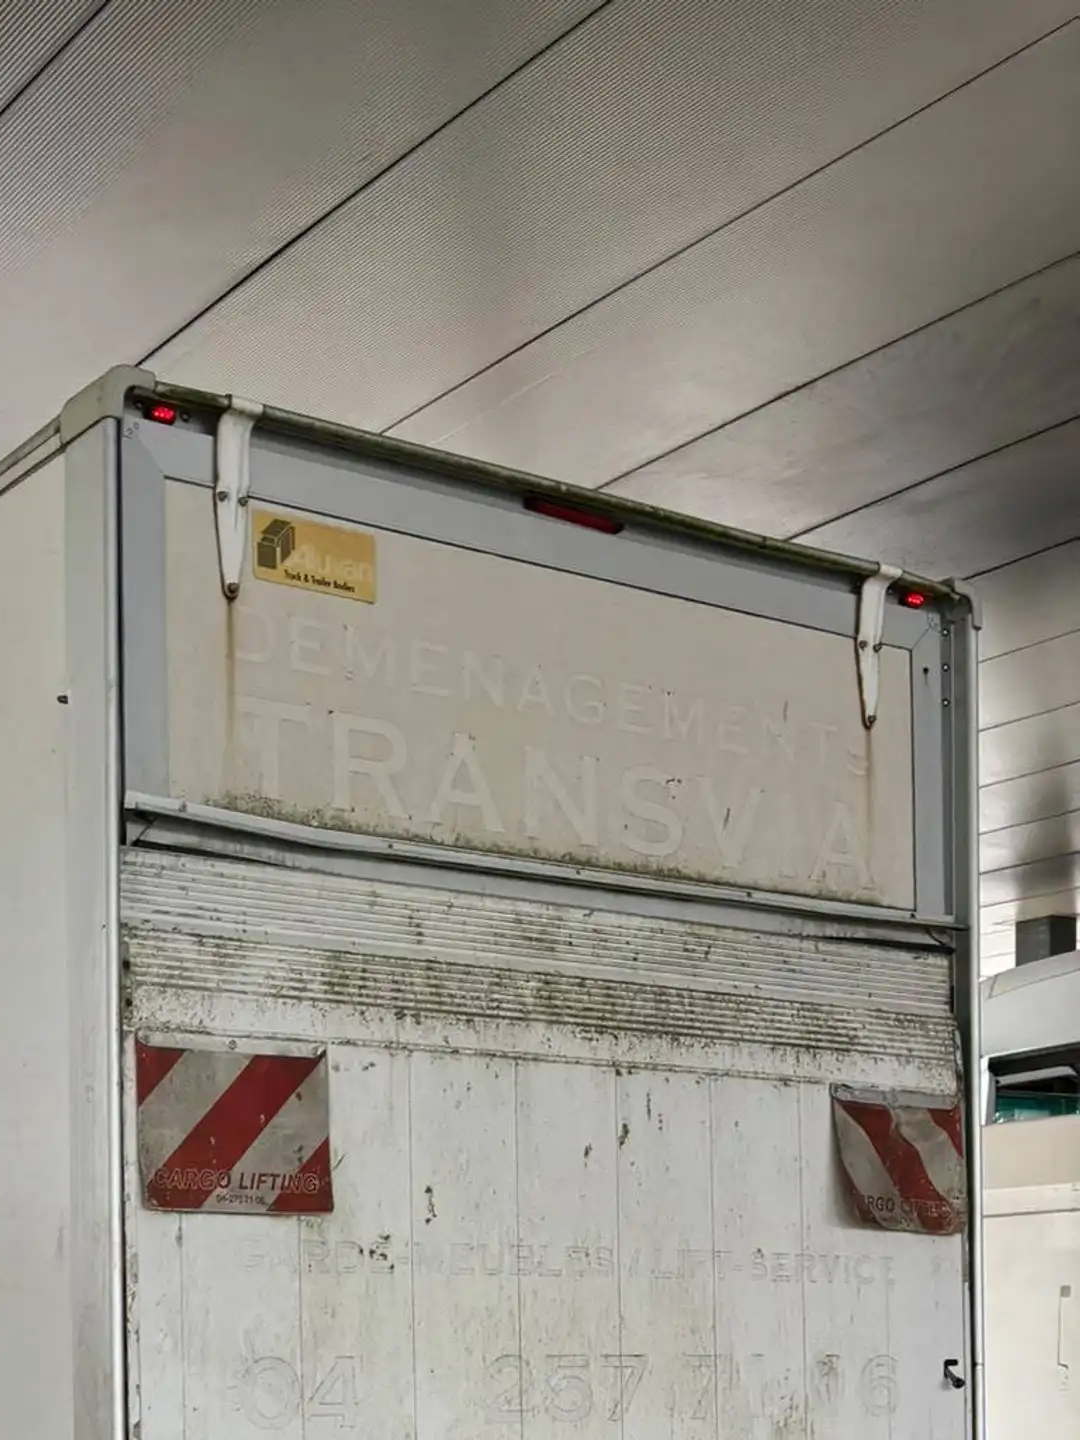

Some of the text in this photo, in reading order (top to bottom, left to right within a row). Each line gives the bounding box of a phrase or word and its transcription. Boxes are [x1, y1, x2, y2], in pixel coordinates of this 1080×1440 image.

[232, 697, 880, 893] TRANSVIA
[155, 1168, 319, 1194] CARGO LIFTING
